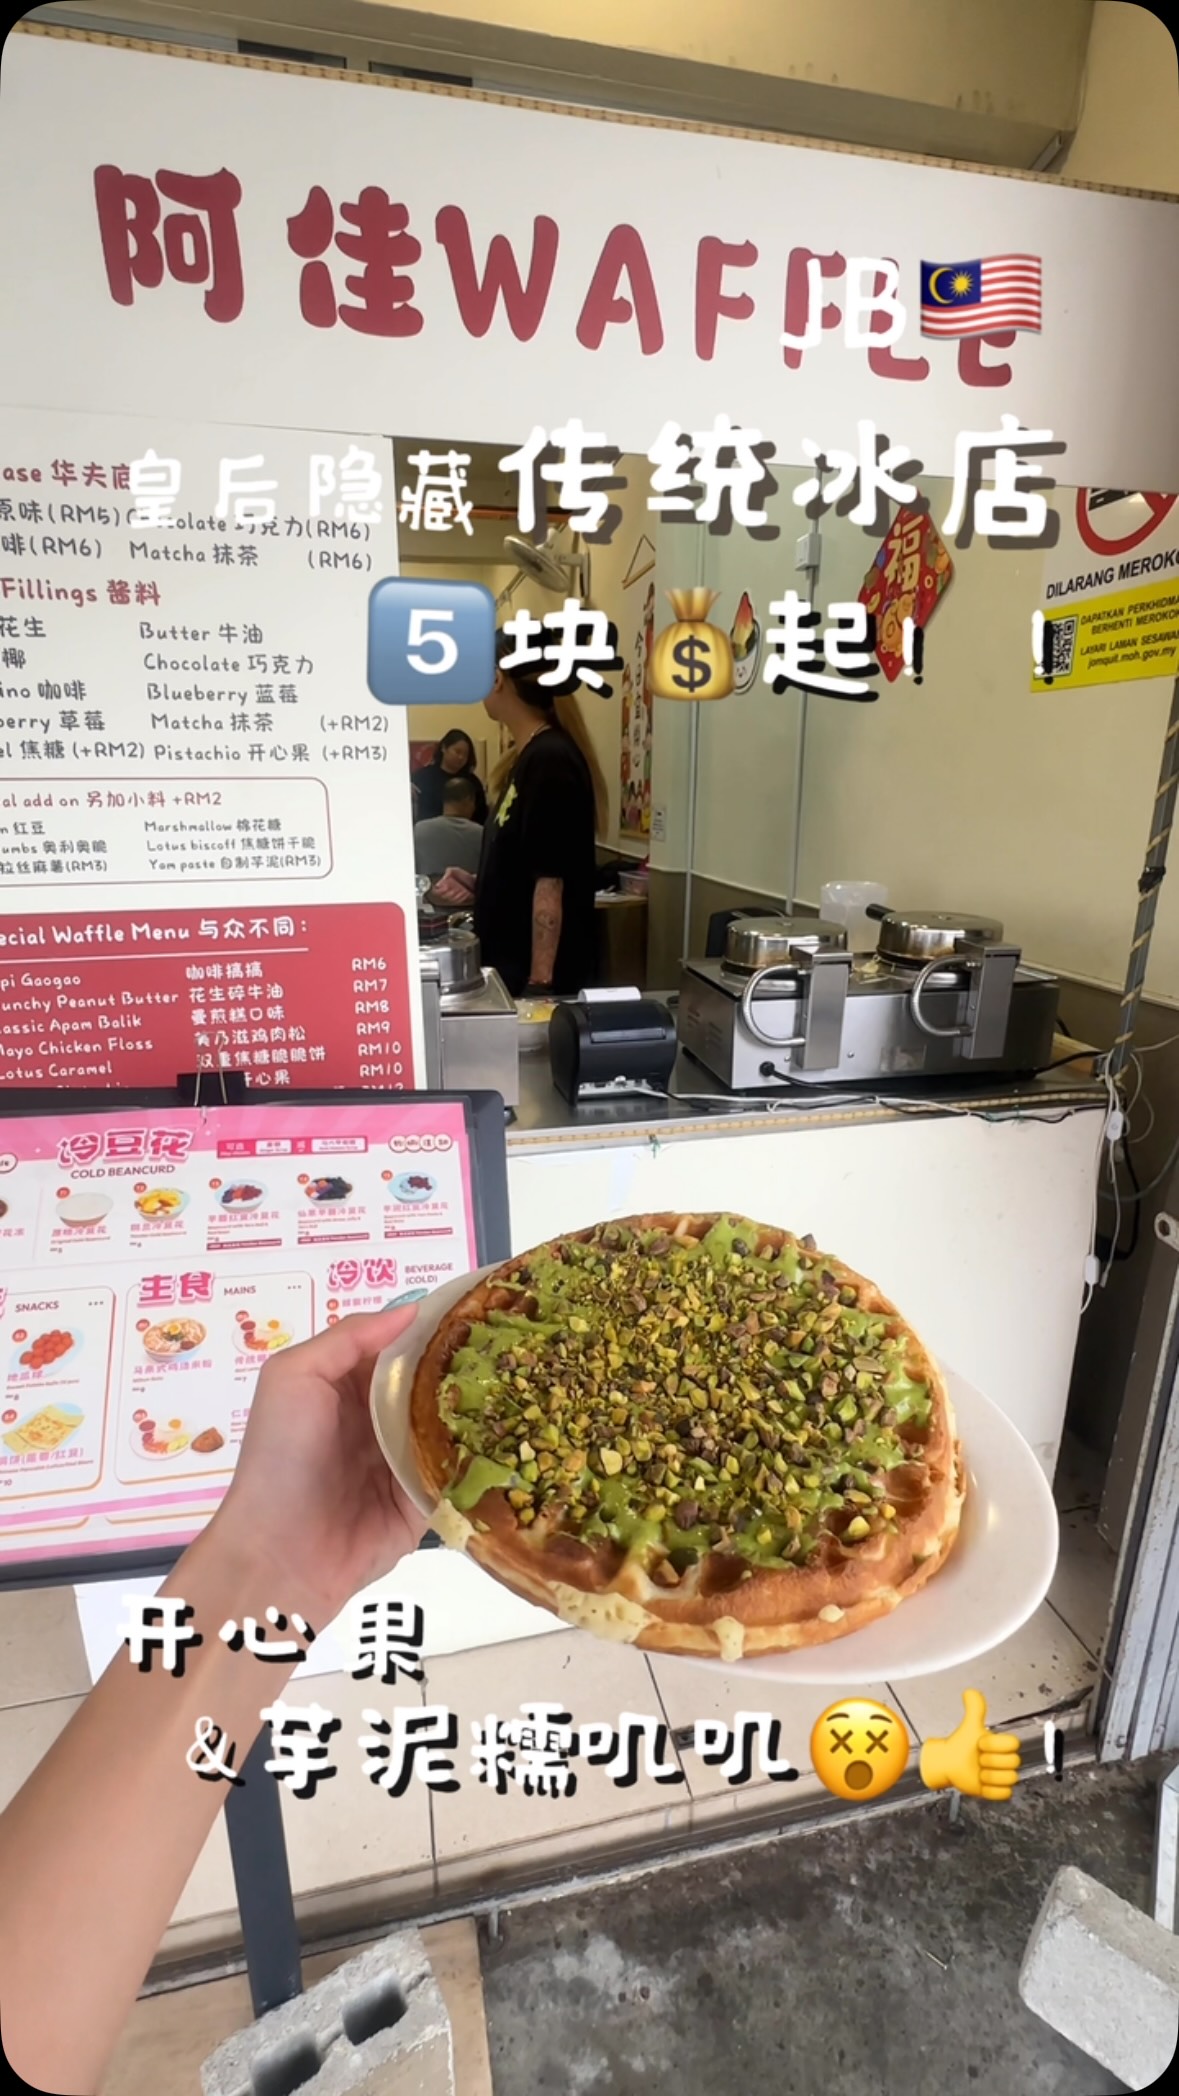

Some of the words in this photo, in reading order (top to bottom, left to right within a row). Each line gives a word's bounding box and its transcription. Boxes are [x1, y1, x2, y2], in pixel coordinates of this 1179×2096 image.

[51, 459, 130, 490] 华夫底
[129, 541, 206, 562] Matcha
[213, 543, 258, 566] 抹茶
[308, 551, 372, 571] (RM6)
[882, 510, 924, 590] 福
[1046, 567, 1115, 599] DILARANG
[1118, 549, 1179, 580] MEROK
[0, 578, 97, 607] Fillings
[107, 579, 161, 606] 酱料
[0, 615, 46, 638] 花生
[139, 622, 210, 640] Butter
[218, 623, 263, 644] 牛油
[1091, 618, 1133, 635] BERHENTI
[1109, 638, 1139, 651] LAMAN
[143, 653, 240, 672] Chocolate
[247, 654, 314, 675] 巧克力
[37, 679, 87, 700] 咖啡
[147, 683, 248, 706] Blueberry
[255, 683, 298, 704] 蓝莓
[59, 709, 105, 731] 草莓
[151, 713, 223, 730] Matcha
[230, 712, 274, 732] 抹茶
[320, 715, 389, 733] (+RM2)
[20, 740, 65, 760] 焦糖
[73, 741, 145, 760] (+RM2)
[154, 744, 241, 761] Pistachio
[247, 743, 310, 763] 开心果
[323, 745, 388, 762] (+RM3)
[23, 793, 53, 808] add
[59, 797, 79, 808] on
[87, 790, 165, 808] 另加小料
[174, 791, 222, 806] +RM2
[13, 821, 45, 835] 红豆
[144, 820, 232, 832] Marshmallow
[236, 818, 282, 832] 棉花糖
[42, 840, 107, 854] 奥利奥脆
[146, 839, 186, 851] Lotus
[191, 838, 236, 850] biscoff
[149, 858, 175, 870] Yam
[180, 860, 215, 872] paste
[52, 923, 125, 944] Waffle
[131, 922, 190, 941] Menu
[21, 972, 81, 990] Gaogao
[352, 957, 387, 971] RM6
[57, 994, 116, 1009] Peanut
[121, 991, 179, 1006] Butter
[189, 983, 284, 1003] 花生碎牛油
[353, 978, 388, 993] RM7
[0, 1019, 45, 1035] assic
[50, 1018, 92, 1035] Apam
[98, 1014, 142, 1030] Balik
[355, 1000, 390, 1014] RM8
[38, 1040, 102, 1056] Chicken
[107, 1037, 153, 1051] Floss
[356, 1021, 391, 1036] RM9
[48, 1060, 112, 1077] Caramel
[358, 1041, 402, 1057] RM10
[359, 1062, 403, 1078] RM10
[59, 1129, 193, 1166] 冷豆花
[70, 1166, 105, 1179] COLD
[108, 1164, 175, 1177] BEANCURD
[328, 1258, 394, 1288] 冷饮
[404, 1263, 454, 1274] BEVERAGE
[405, 1275, 438, 1285] (COLD)
[138, 1271, 212, 1304] 主食
[224, 1286, 257, 1297] MAINS
[15, 1301, 60, 1313] SNACKS
